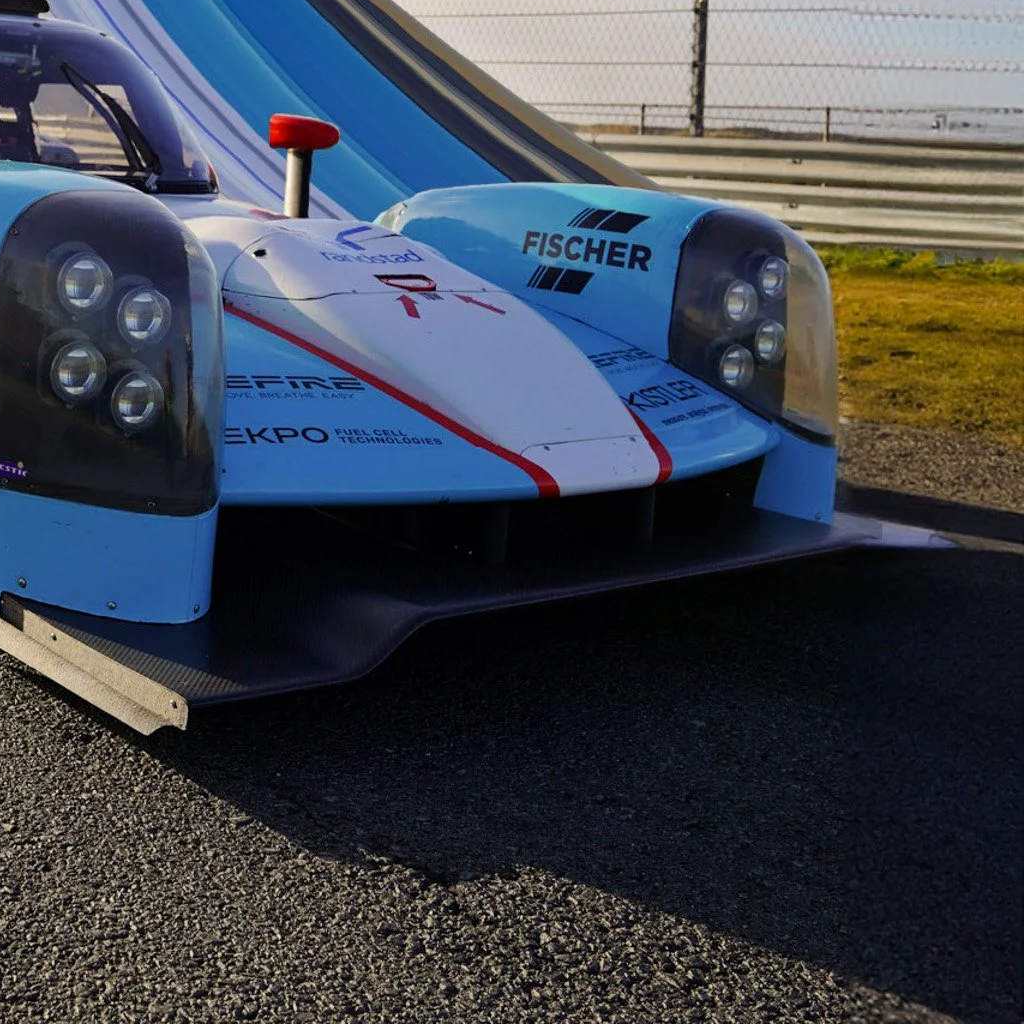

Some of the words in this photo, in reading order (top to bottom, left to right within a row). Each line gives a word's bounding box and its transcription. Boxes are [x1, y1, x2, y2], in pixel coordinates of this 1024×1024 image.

[319, 248, 424, 264] randstad
[522, 230, 653, 273] FISCHER
[226, 375, 365, 390] EFIRE
[621, 380, 709, 412] KISTLER
[224, 427, 330, 444] EKPO
[334, 428, 370, 437] FUEL
[373, 429, 409, 437] CELL
[338, 436, 444, 446] TECHNOLOGIES
